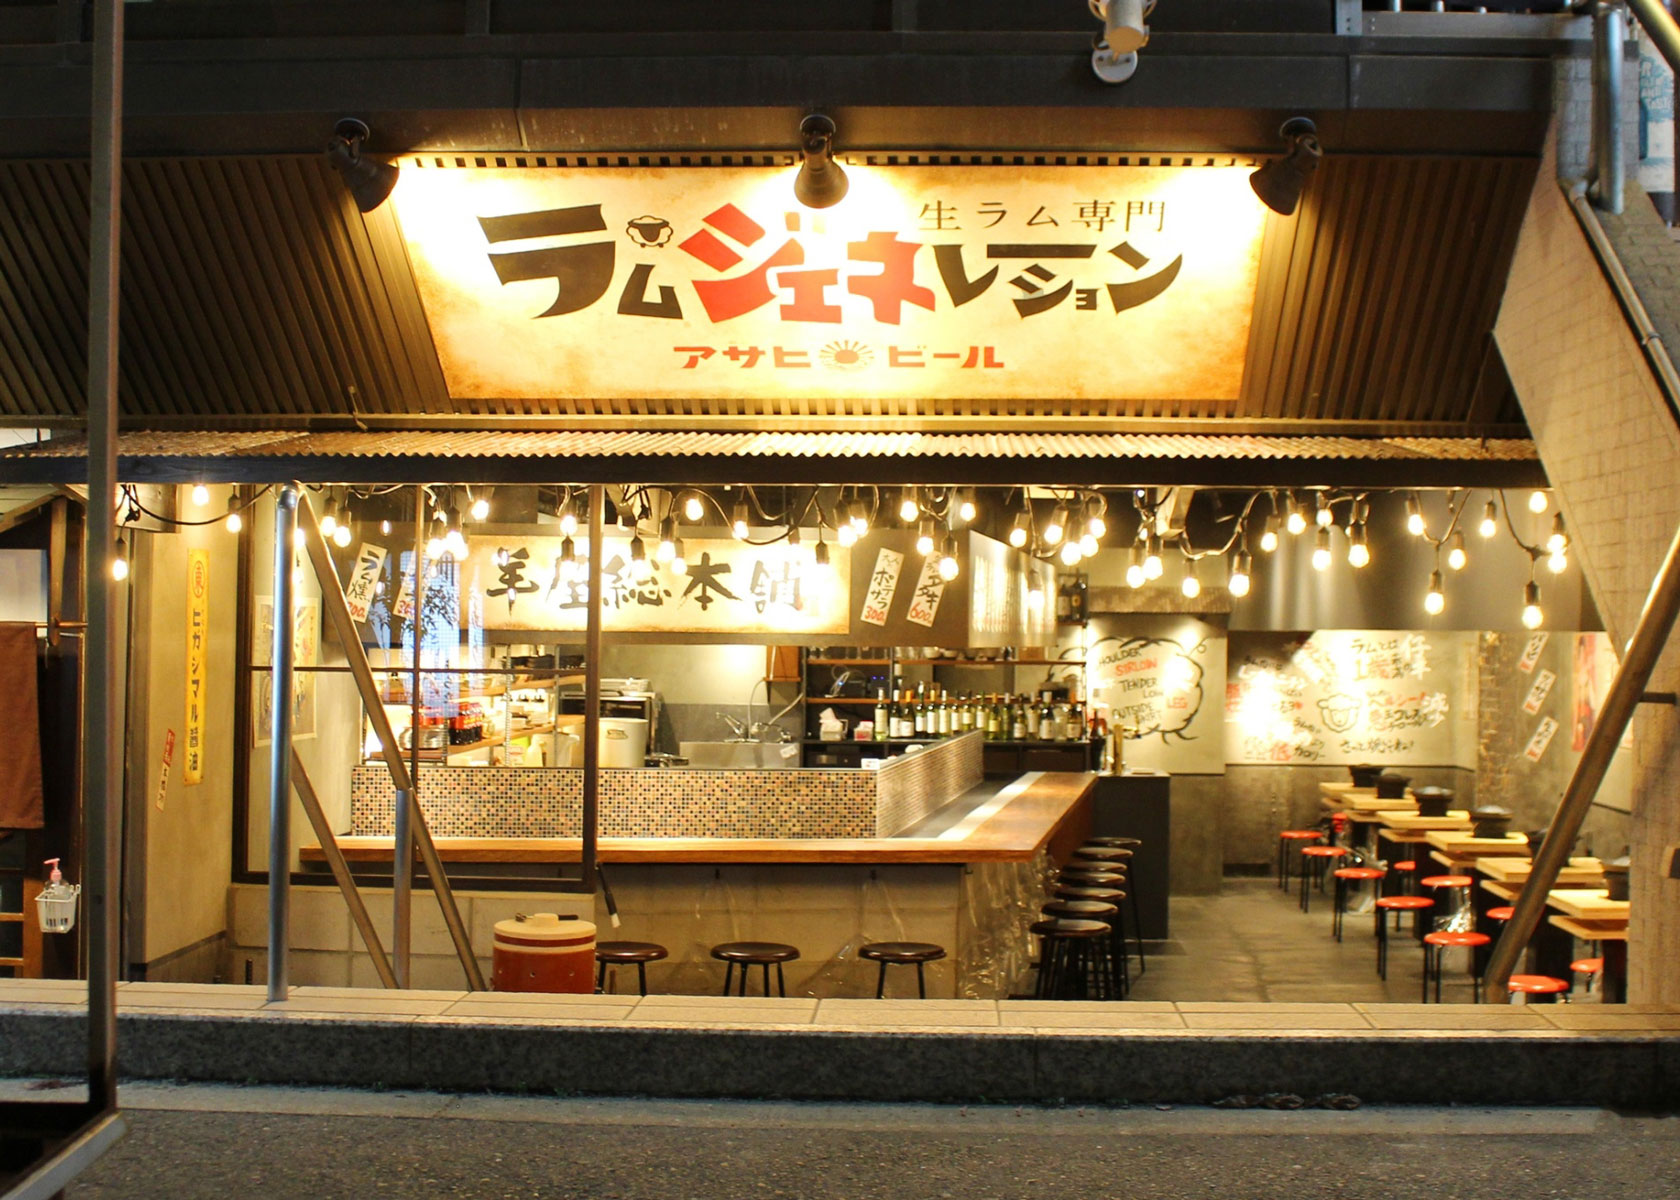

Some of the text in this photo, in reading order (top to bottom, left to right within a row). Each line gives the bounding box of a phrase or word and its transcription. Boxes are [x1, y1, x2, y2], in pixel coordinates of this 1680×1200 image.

[918, 199, 1165, 233] 生ラム専門
[476, 202, 1183, 326] ラムジェネレーション
[673, 344, 1005, 369] アサヒ ビール
[1119, 678, 1158, 693] TENDER
